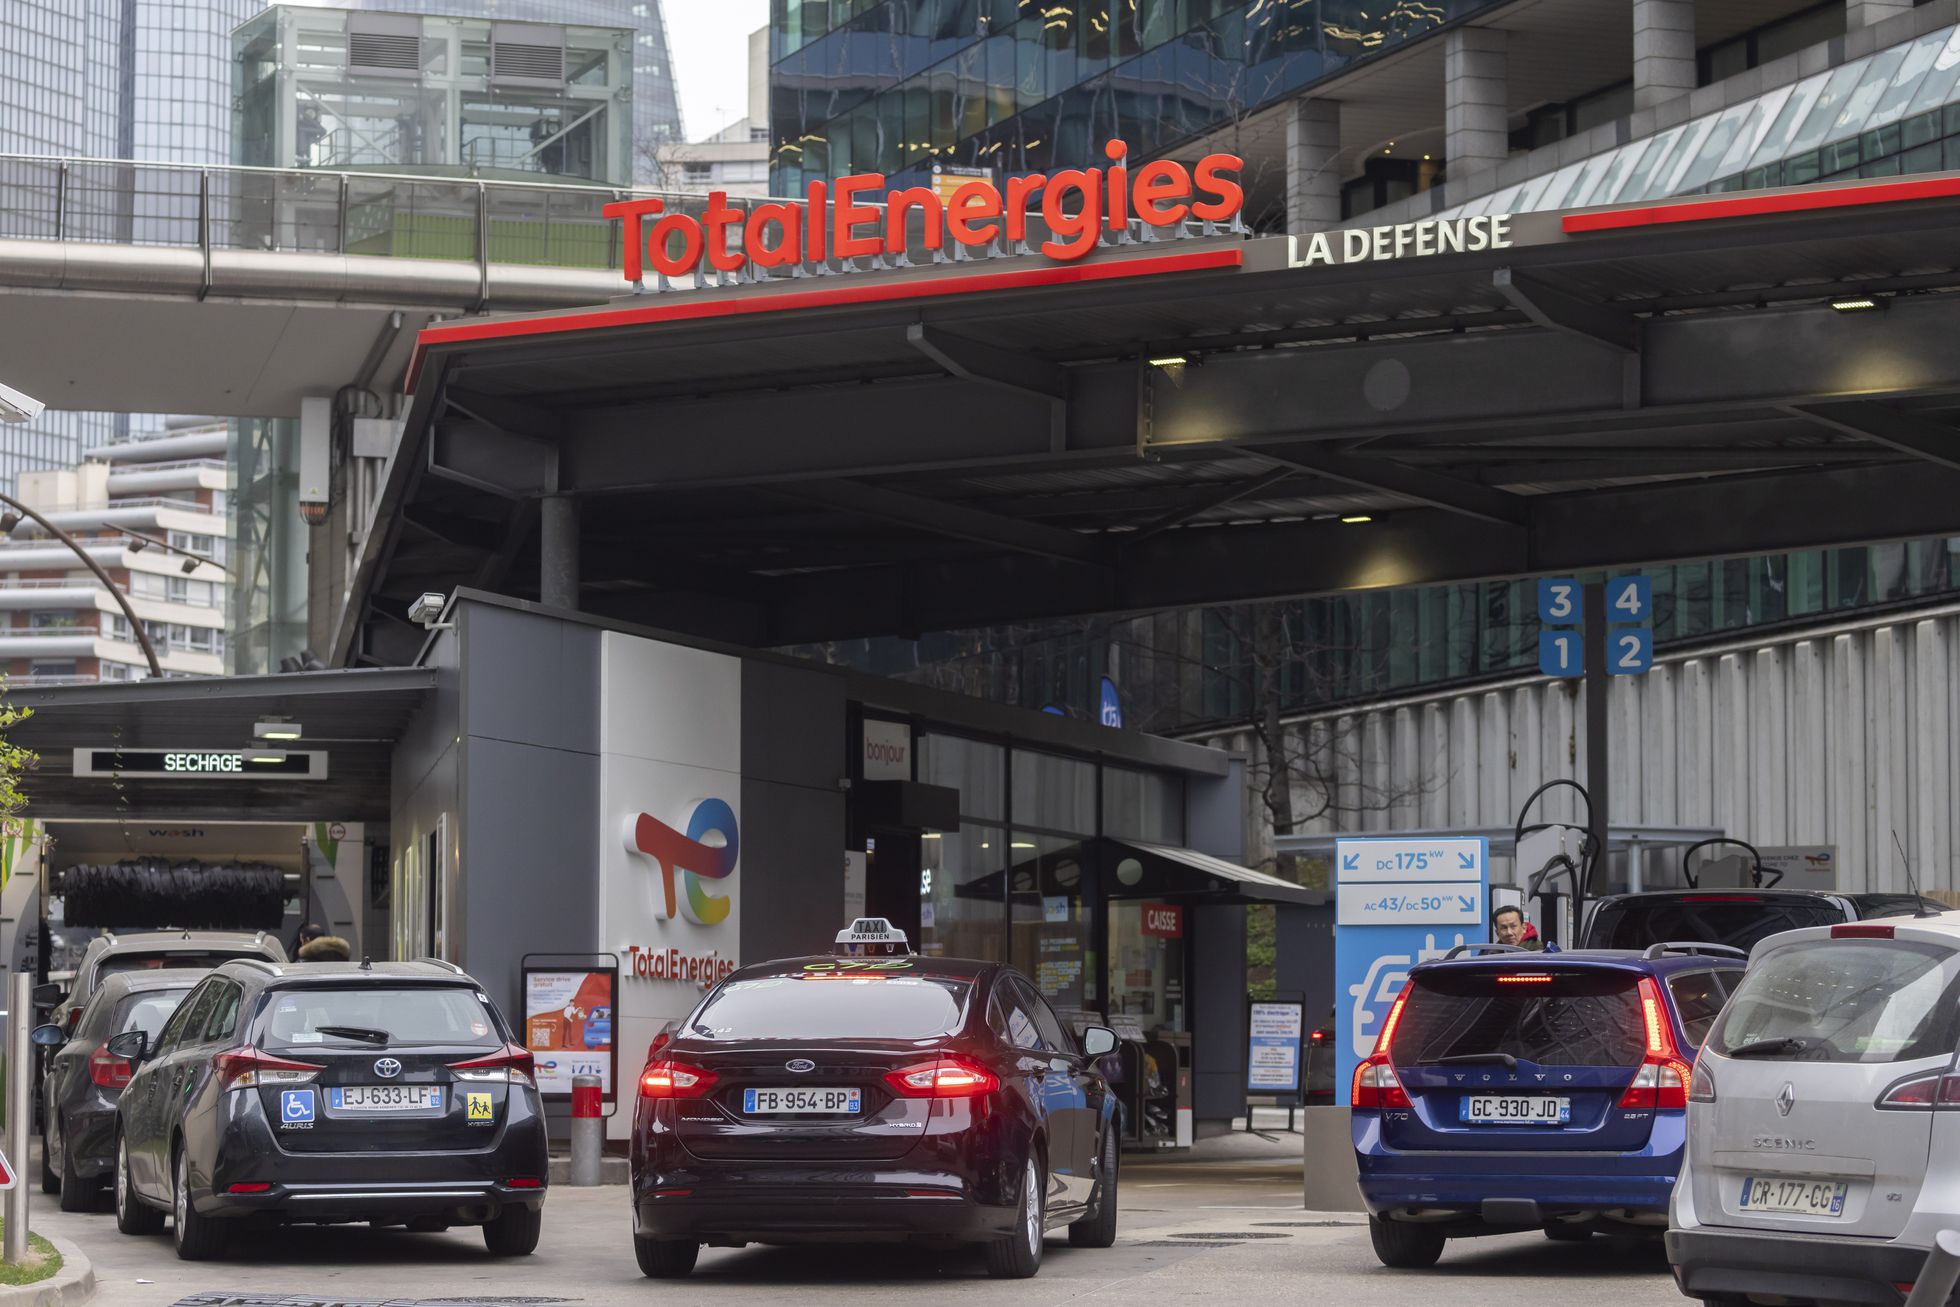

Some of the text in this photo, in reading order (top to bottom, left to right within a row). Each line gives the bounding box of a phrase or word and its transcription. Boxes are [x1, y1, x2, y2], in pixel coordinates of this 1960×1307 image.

[602, 138, 1244, 282] TotalEnergies
[1288, 213, 1514, 268] LA DEFENSE
[1549, 585, 1572, 618] 3
[1615, 583, 1642, 615] 4
[1554, 637, 1569, 669] 1
[1618, 635, 1642, 668] 2
[164, 753, 243, 772] SECHAGE
[866, 737, 905, 767] bonjour
[149, 828, 205, 838] wash
[1376, 850, 1444, 870] DC 175 kW
[1364, 903, 1377, 911] AC
[1420, 897, 1442, 911] 50
[857, 921, 884, 933] TAXI
[1148, 910, 1177, 932] CAISSE
[629, 945, 735, 990] TotalEnergies
[343, 1087, 429, 1105] EJ-633-LF
[431, 1096, 440, 1105] 92
[757, 1092, 847, 1110] FB-954-BP
[849, 1102, 858, 1111] 93
[1384, 1112, 1409, 1121] V70
[1472, 1099, 1557, 1118] GC-930-JD
[1560, 1110, 1570, 1119] 44
[1752, 1136, 1816, 1150] SCENIC
[1751, 1181, 1832, 1208] CR-177-CG
[1832, 1199, 1841, 1211] 16
